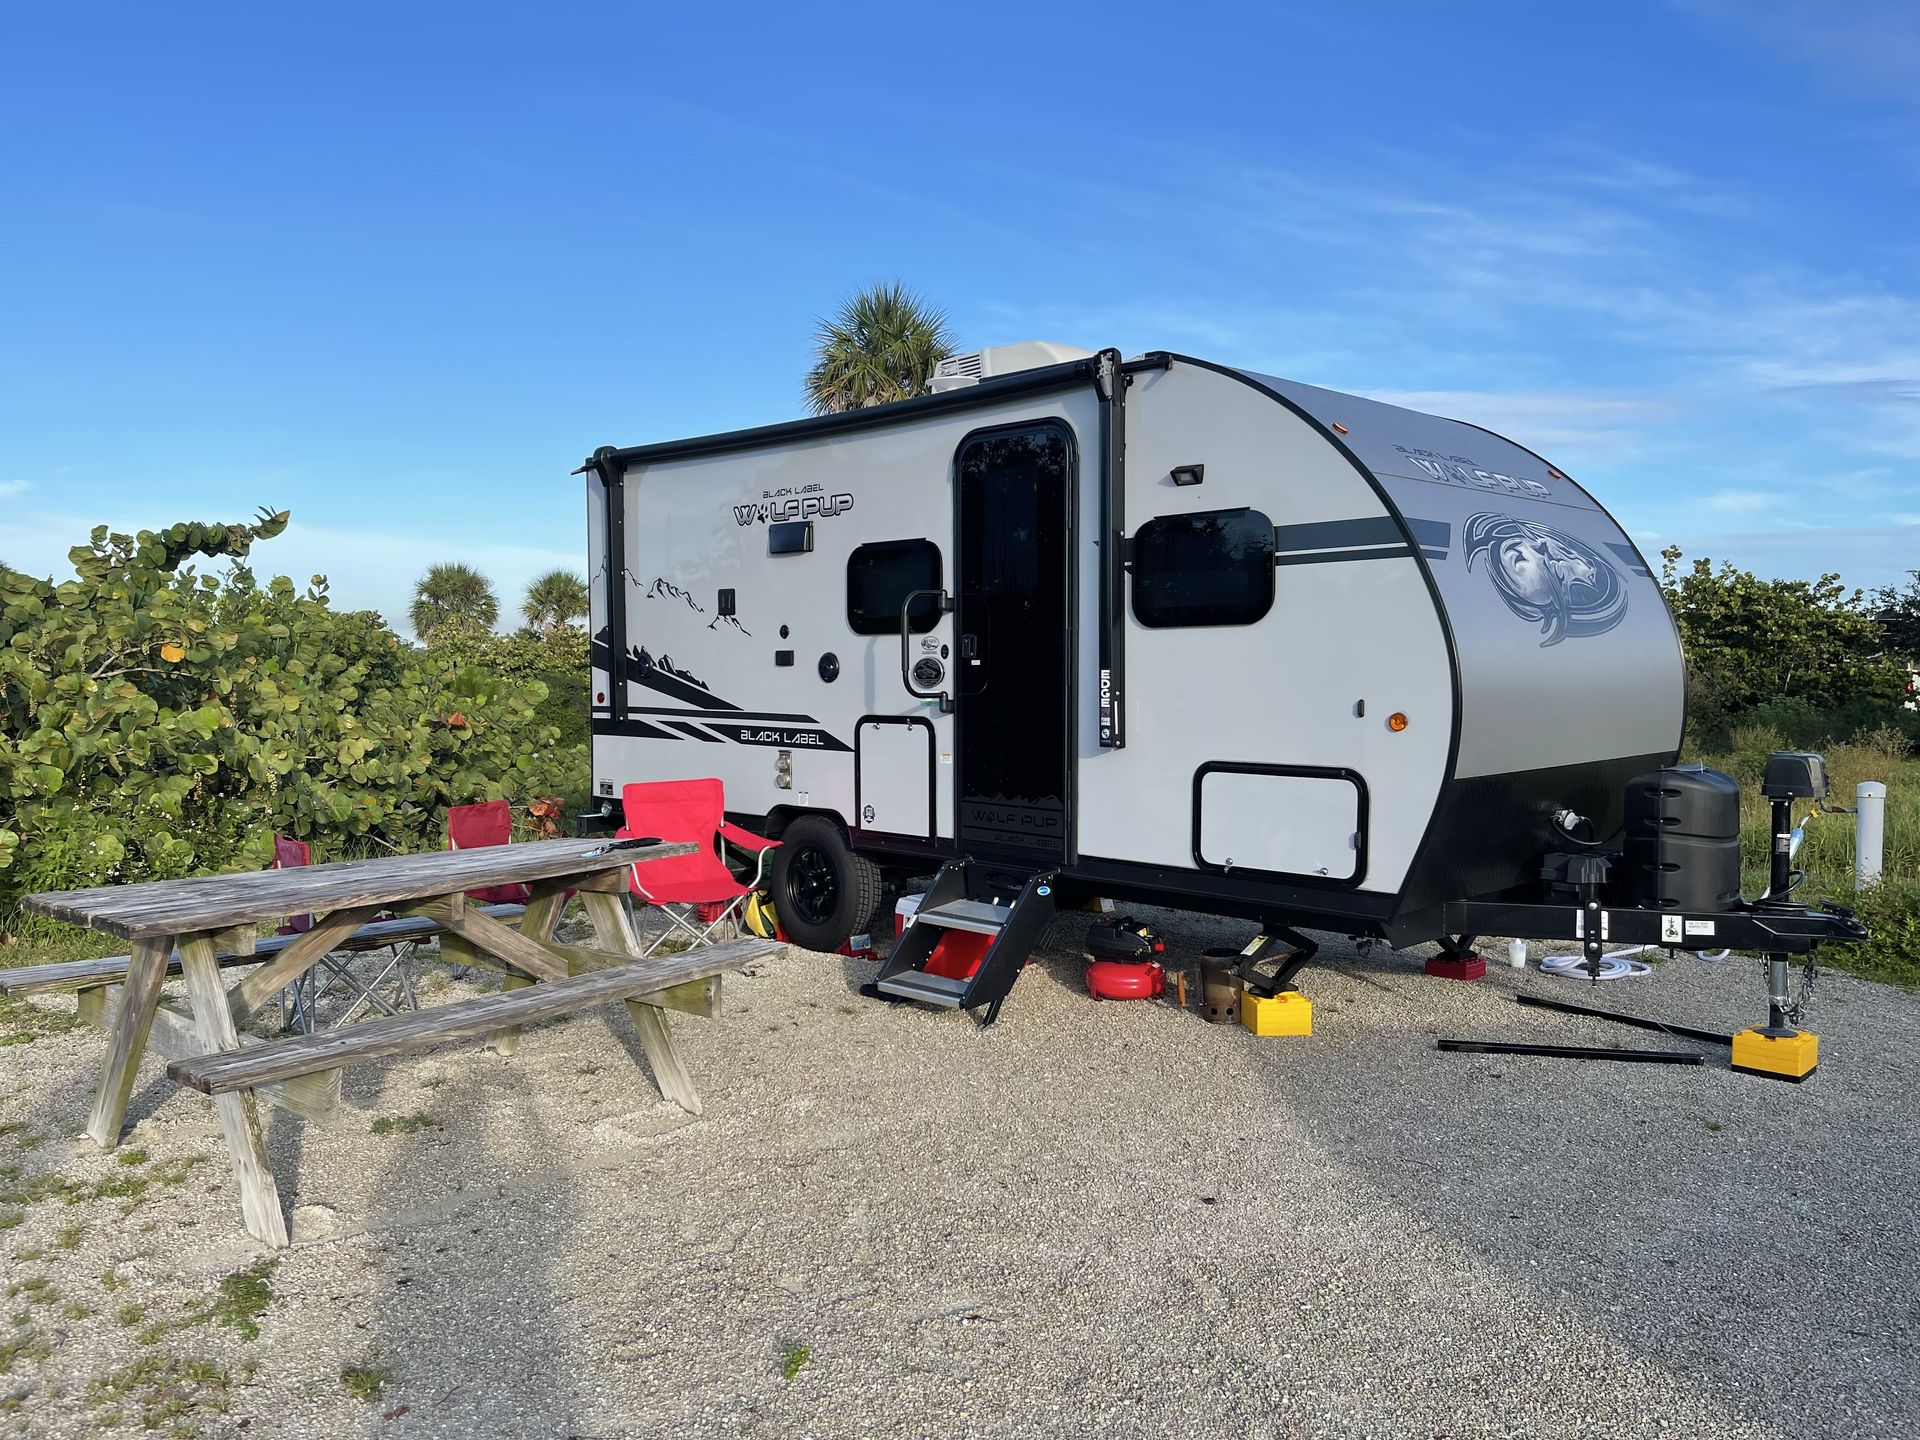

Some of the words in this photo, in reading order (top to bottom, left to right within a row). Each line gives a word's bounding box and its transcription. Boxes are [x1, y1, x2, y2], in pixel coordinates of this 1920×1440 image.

[762, 488, 792, 499] BLACK
[795, 484, 824, 494] LABEL
[1491, 472, 1552, 498] PUP
[802, 493, 854, 519] PUP
[1101, 669, 1111, 707] EDGE
[740, 730, 780, 742] BLACK
[783, 732, 825, 745] LABEL
[1021, 814, 1058, 828] PUP
